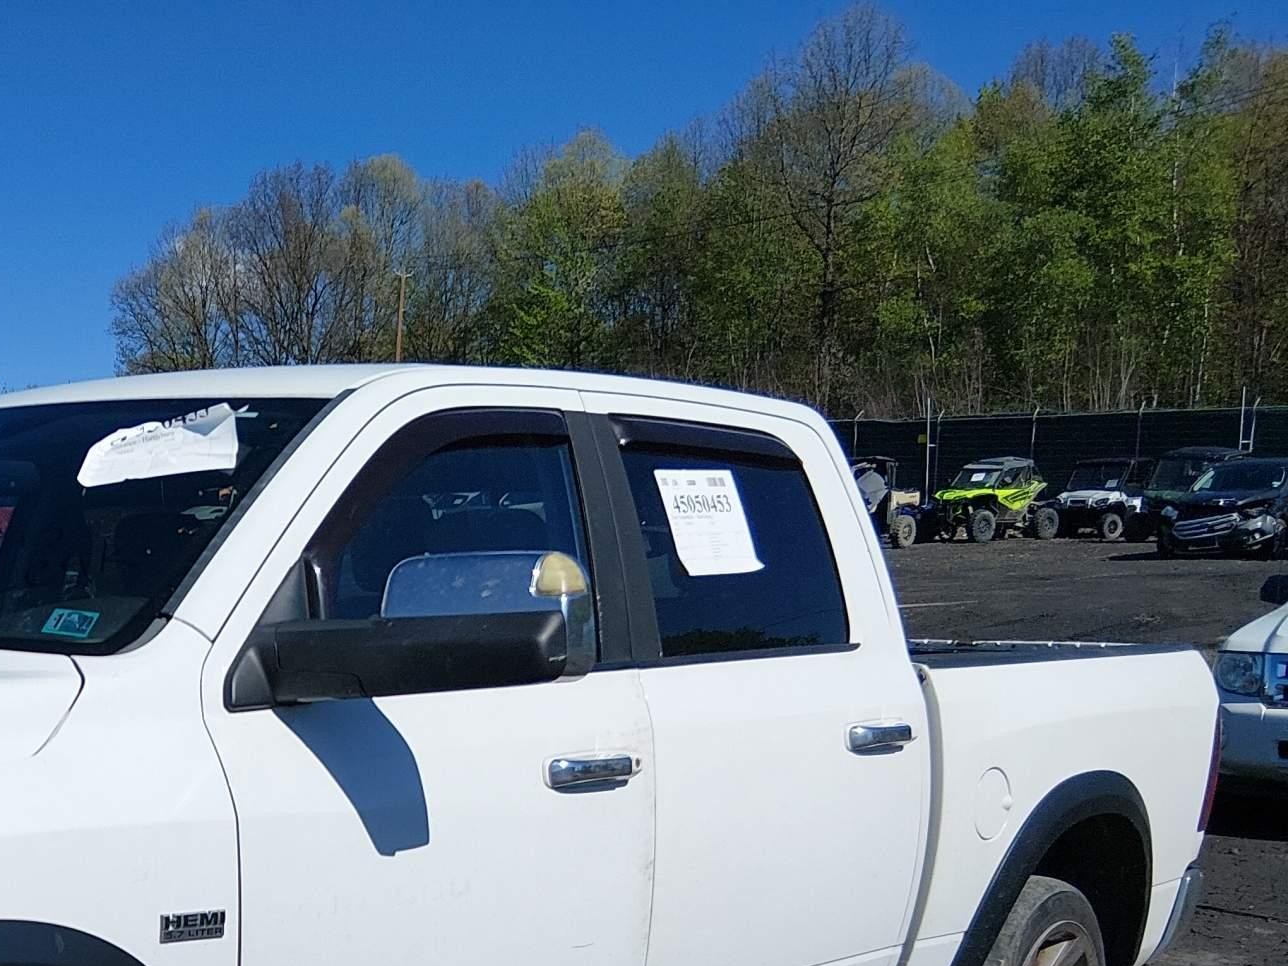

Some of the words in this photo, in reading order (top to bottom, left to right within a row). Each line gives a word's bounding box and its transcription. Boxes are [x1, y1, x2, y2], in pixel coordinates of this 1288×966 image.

[673, 494, 732, 514] 45050453
[160, 910, 226, 930] HEMI
[163, 930, 185, 941] 5.7
[188, 927, 223, 938] LITER
